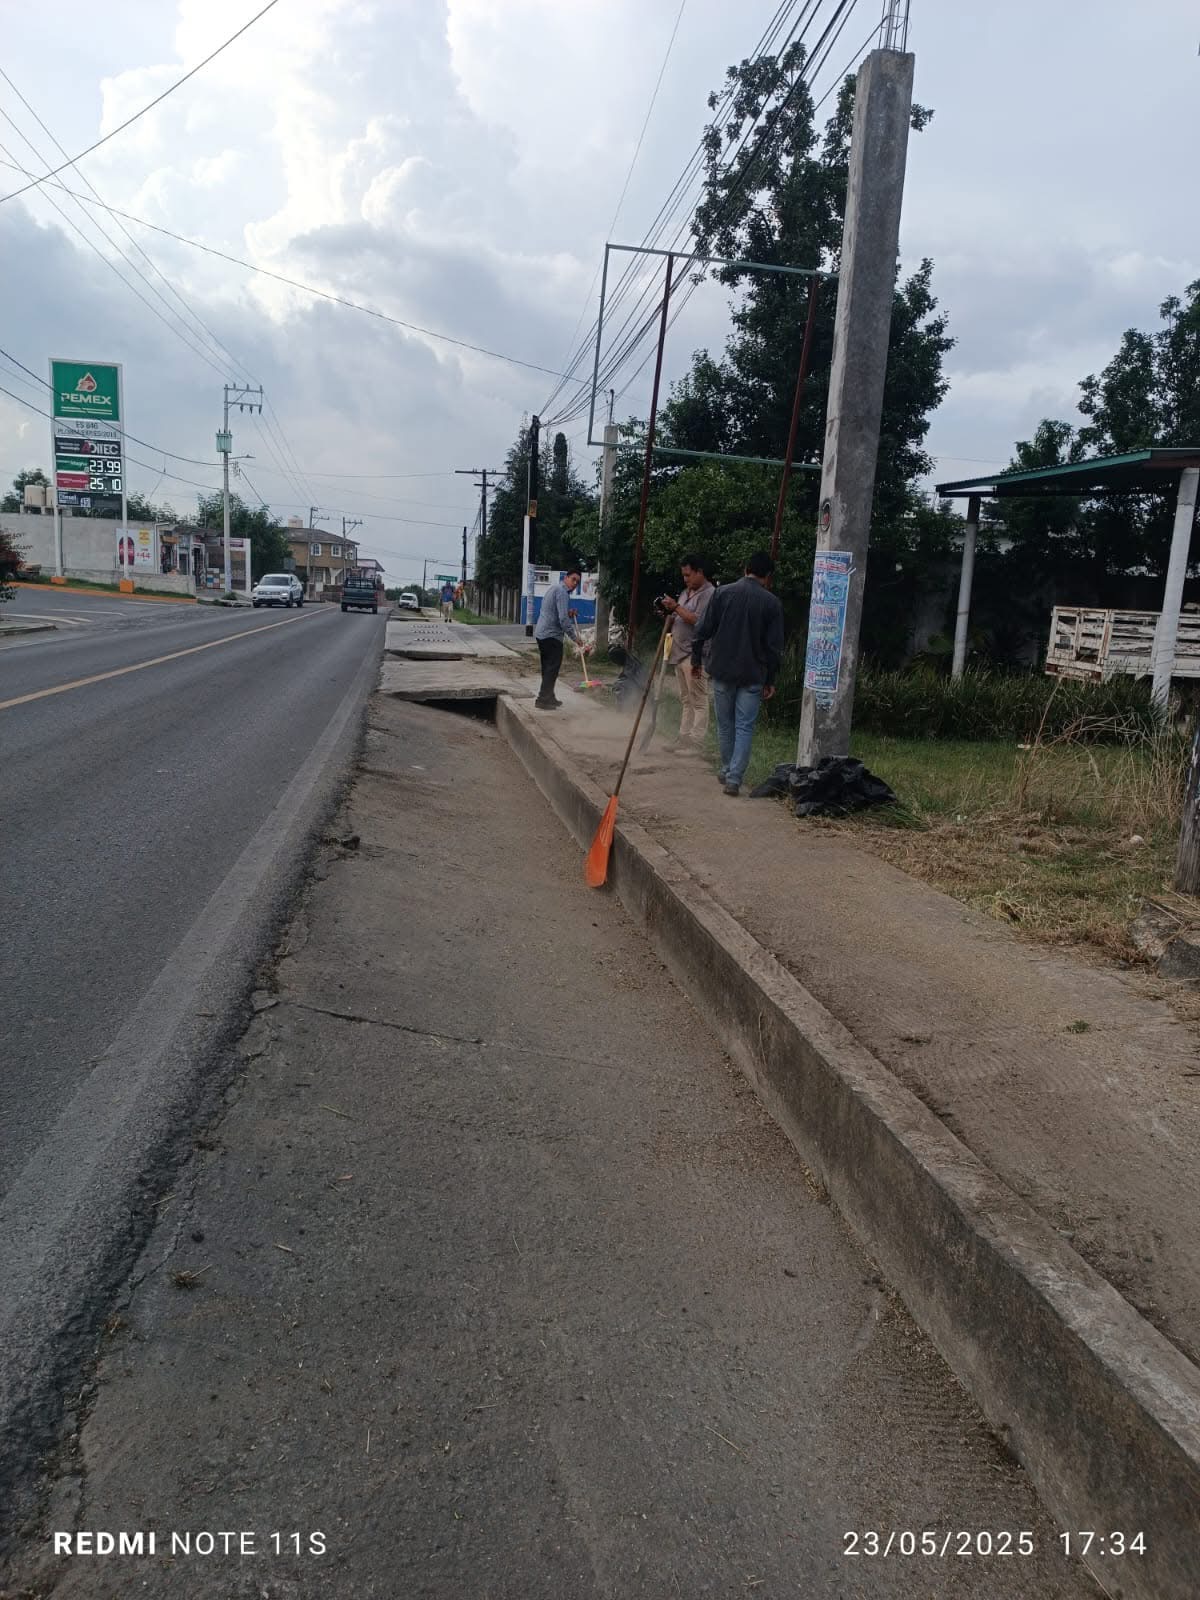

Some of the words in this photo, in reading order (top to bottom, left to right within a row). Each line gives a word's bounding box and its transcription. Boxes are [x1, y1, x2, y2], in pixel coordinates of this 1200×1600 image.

[61, 393, 112, 405] PEMEX
[89, 460, 121, 474] 23.99
[90, 477, 122, 491] 25.10
